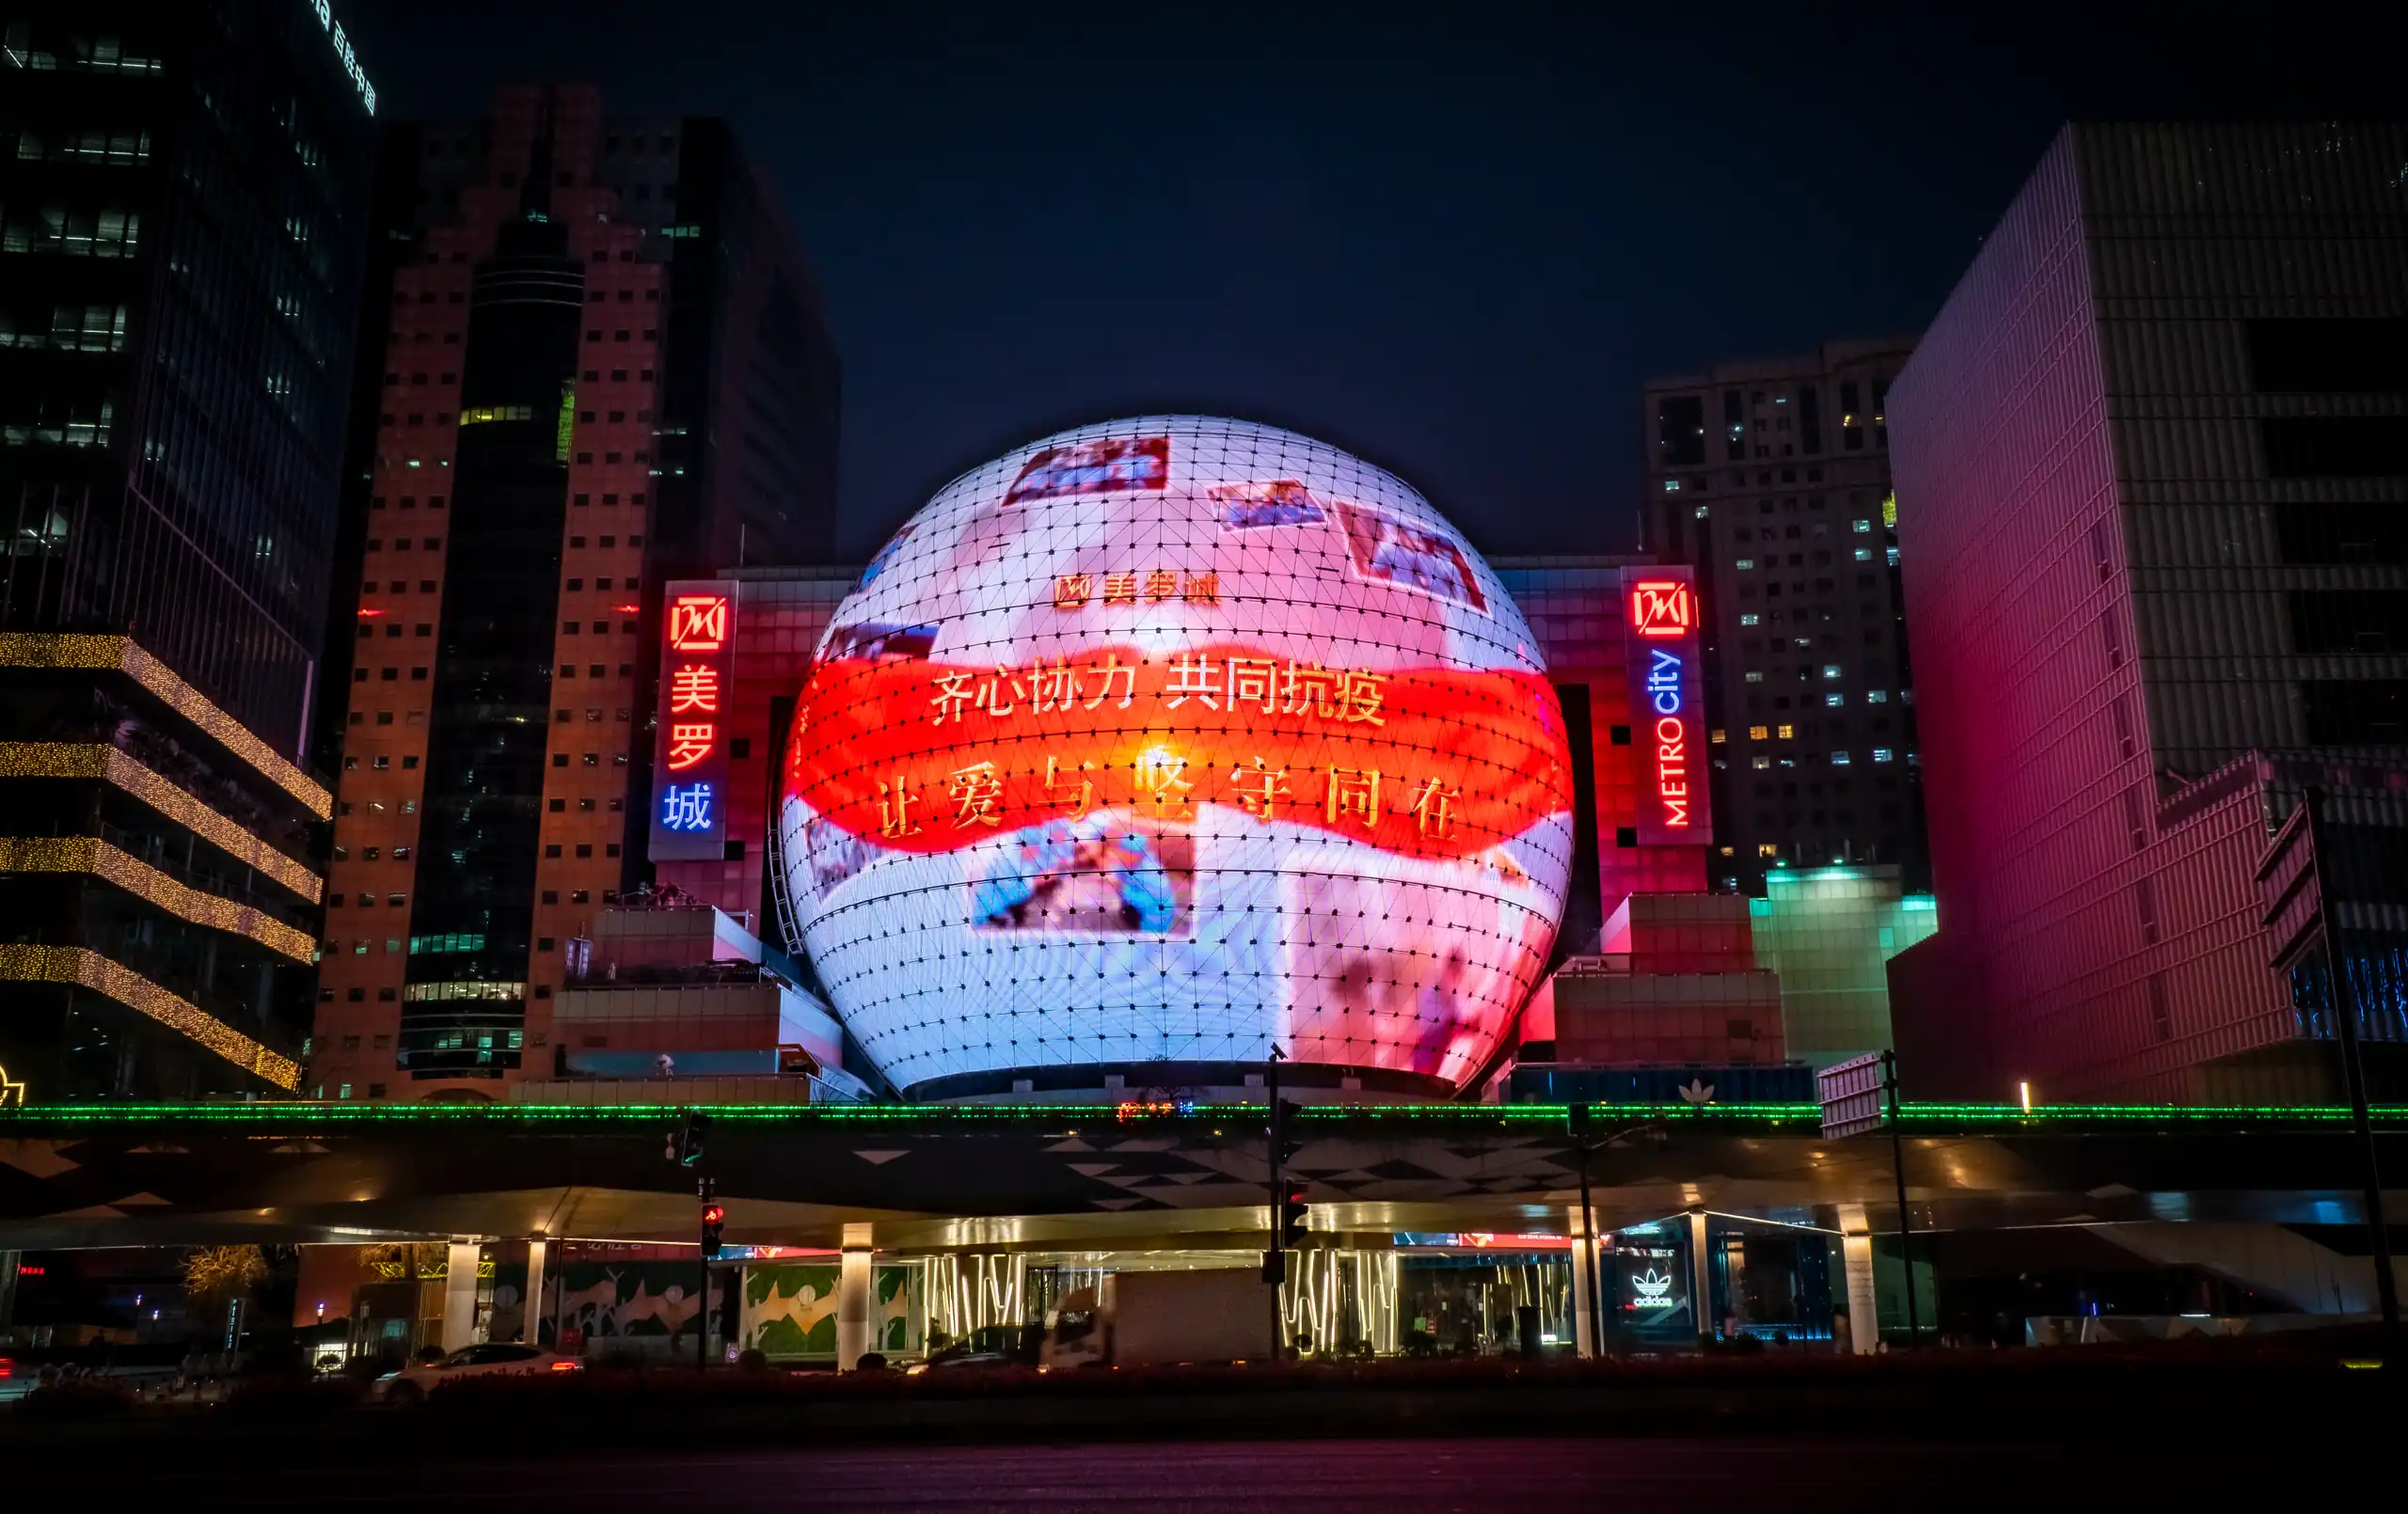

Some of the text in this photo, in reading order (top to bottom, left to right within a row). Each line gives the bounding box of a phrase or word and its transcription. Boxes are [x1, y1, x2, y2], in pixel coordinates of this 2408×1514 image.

[335, 20, 375, 117] 百胜中国
[1103, 572, 1222, 607] 美罗城
[930, 654, 1386, 726] 齐心协力 共同抗疫
[663, 664, 718, 831] 美罗城
[877, 745, 1459, 841] 让爱与坚守同在
[1633, 1295, 1672, 1308] adidas
